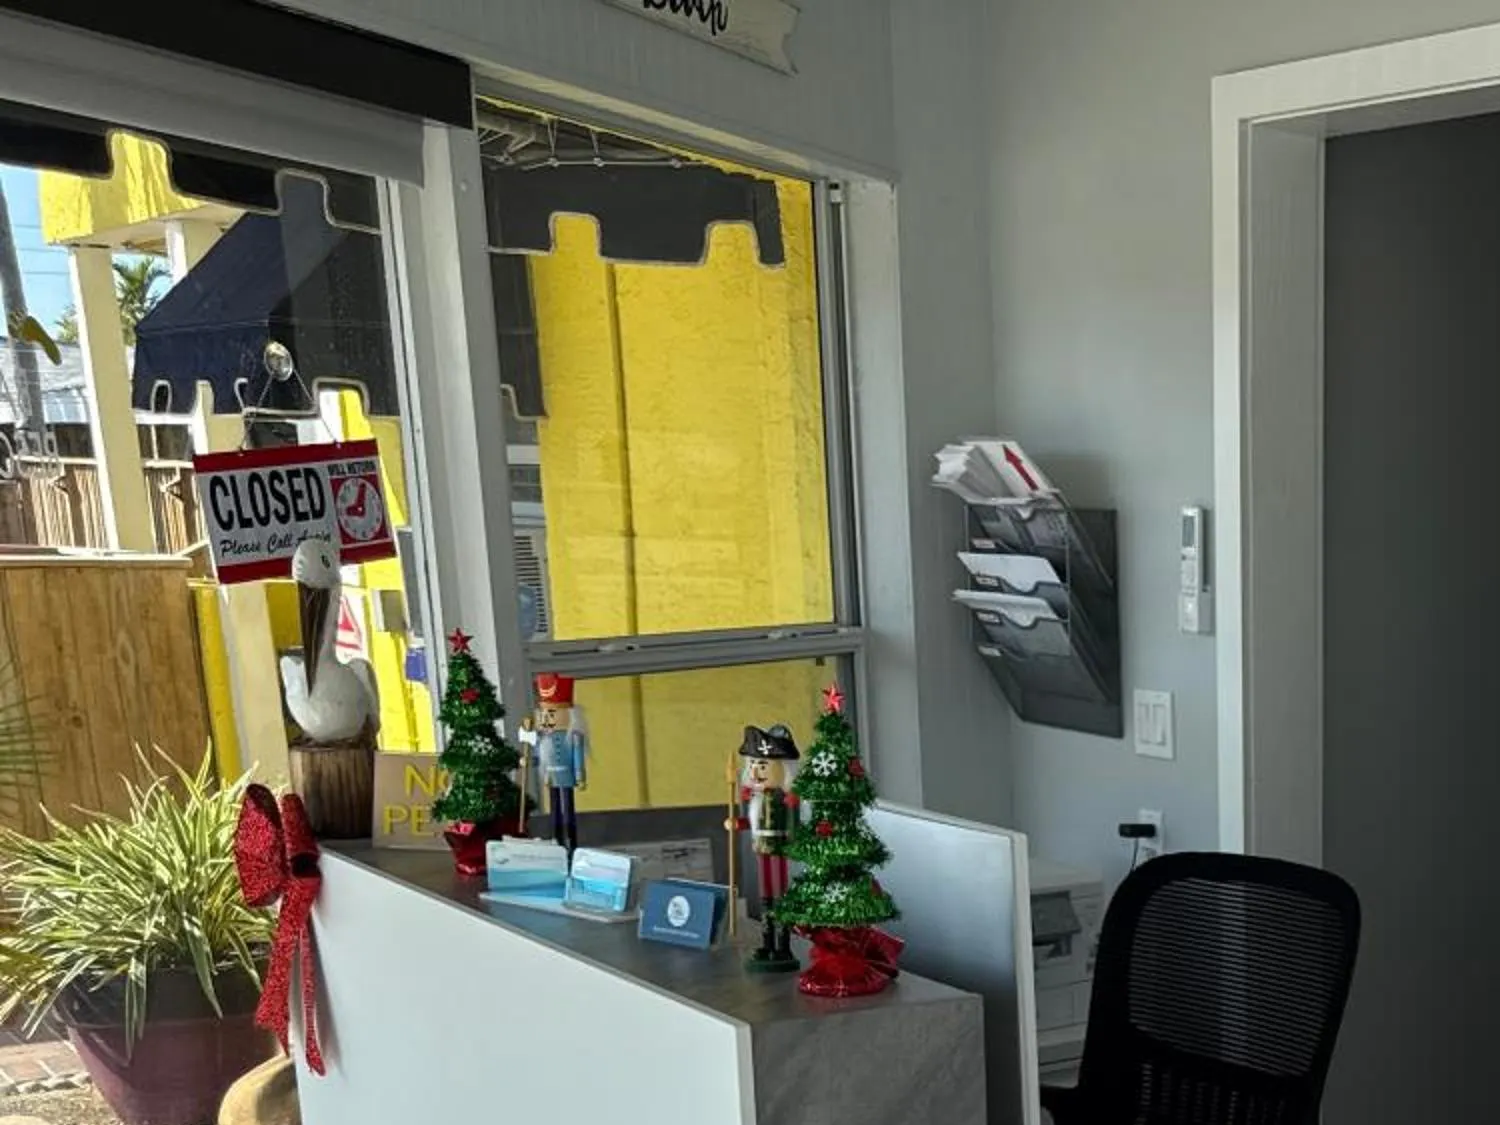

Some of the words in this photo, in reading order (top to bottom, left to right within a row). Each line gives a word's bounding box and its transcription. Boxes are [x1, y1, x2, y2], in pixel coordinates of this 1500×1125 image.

[209, 467, 325, 531] CLOSED
[219, 539, 261, 557] Please
[267, 531, 294, 554] Call
[382, 803, 434, 837] PE
